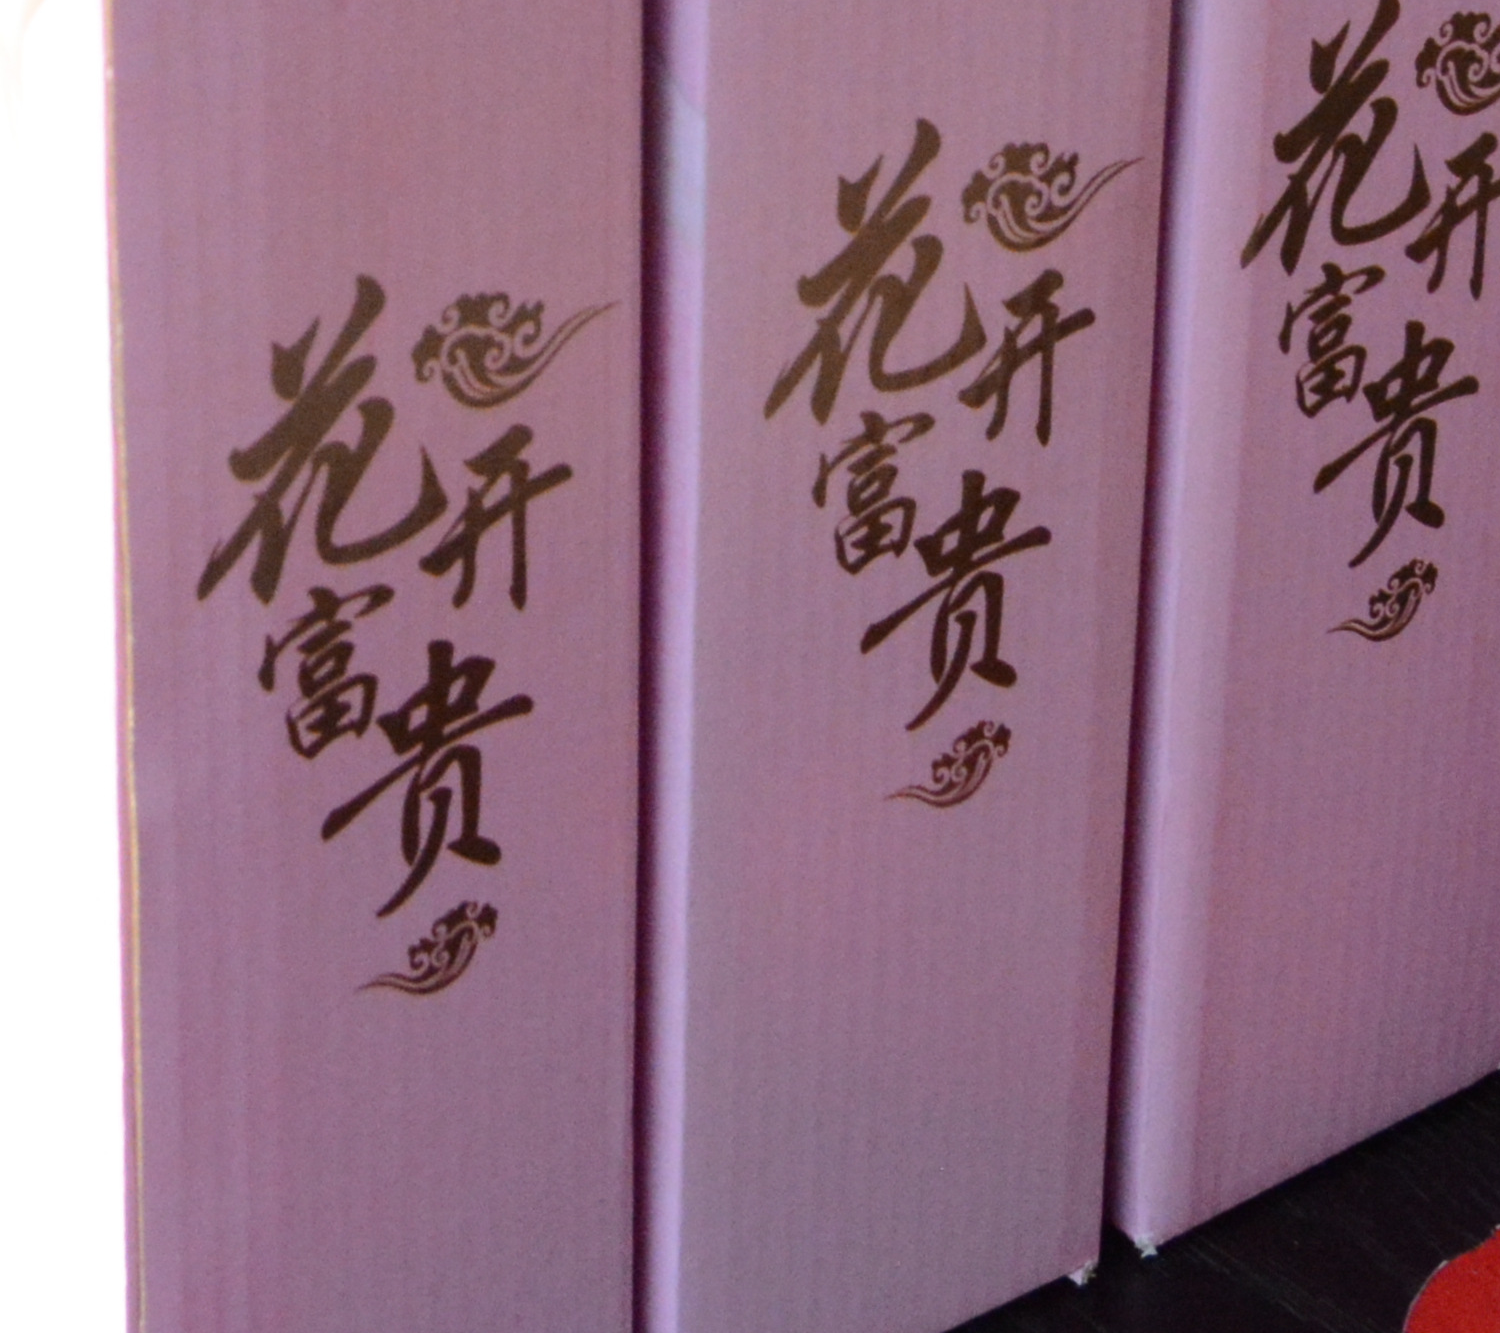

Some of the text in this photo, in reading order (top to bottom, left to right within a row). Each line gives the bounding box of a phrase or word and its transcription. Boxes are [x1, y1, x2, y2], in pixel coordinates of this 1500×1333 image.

[196, 274, 573, 920] 花开富贵
[763, 117, 1096, 732] 花开富贵
